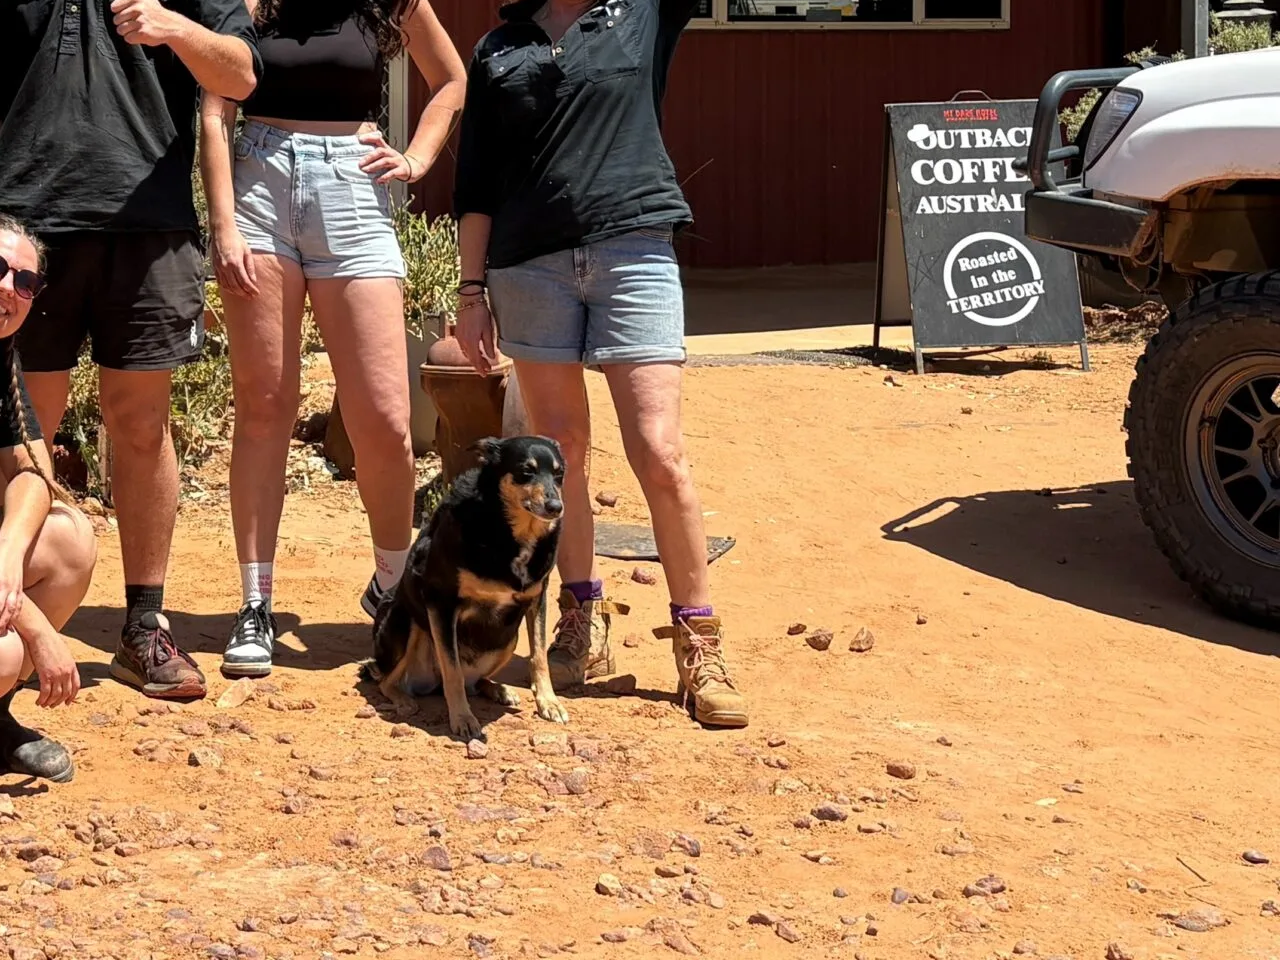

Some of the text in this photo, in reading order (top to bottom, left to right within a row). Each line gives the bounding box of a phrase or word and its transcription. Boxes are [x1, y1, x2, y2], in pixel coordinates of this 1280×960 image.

[916, 192, 1026, 215] AUSTRAL
[958, 246, 1018, 272] Roasted
[991, 269, 1017, 284] the
[947, 280, 1046, 314] TERRITORY
